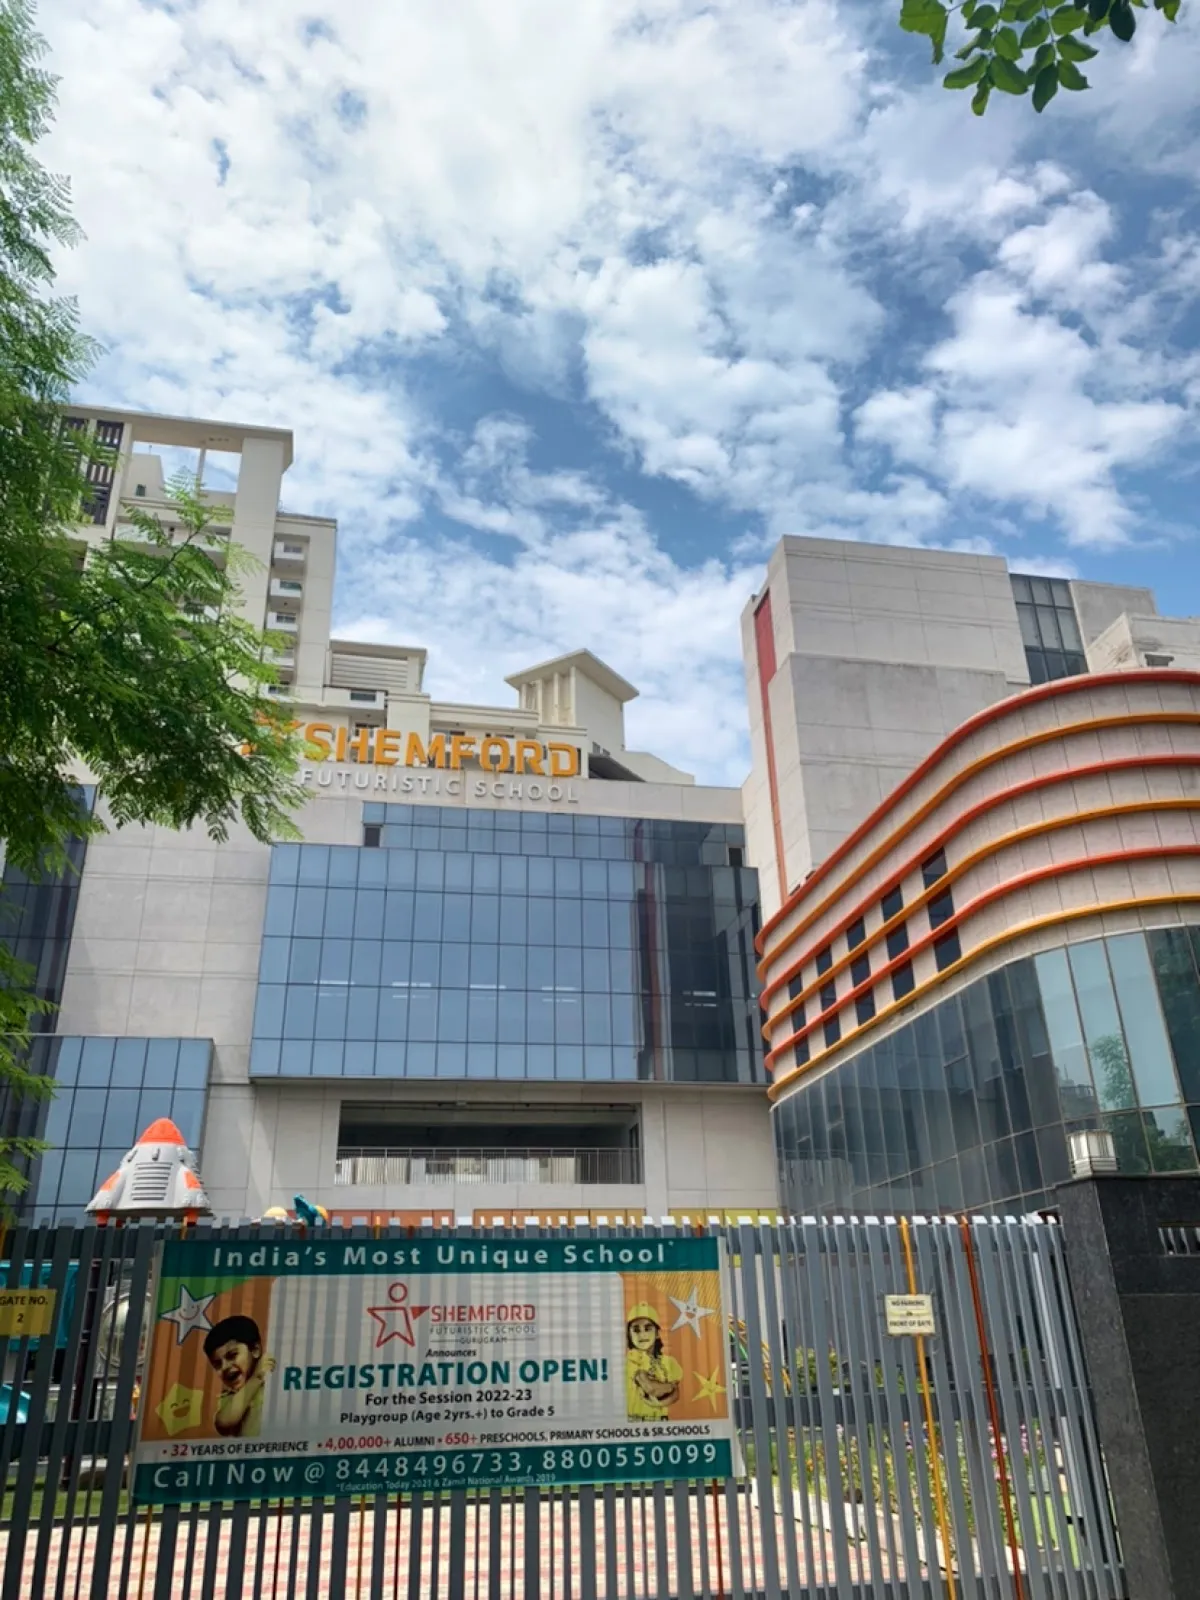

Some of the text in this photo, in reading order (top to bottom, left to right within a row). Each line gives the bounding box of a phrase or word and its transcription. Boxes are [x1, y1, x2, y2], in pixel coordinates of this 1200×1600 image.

[303, 721, 580, 777] SHEMFORD
[300, 768, 579, 803] FUTURISTIC SCHOOL
[343, 1246, 421, 1265] Most
[437, 1245, 549, 1268] Unique
[0, 1295, 48, 1305] GATE NO.
[17, 1313, 24, 1323] 2
[431, 1304, 536, 1322] SHEMFORD
[430, 1325, 536, 1335] FUTURISTIC SCHOOL
[460, 1337, 508, 1345] GURUGRAM
[425, 1349, 477, 1358] Announces
[283, 1357, 608, 1391] REGISTRATION OPEN!
[365, 1389, 533, 1406] For the Session 2022-23
[340, 1405, 555, 1426] Playgroup (Age 2yrs.+) to Grade 5
[325, 1435, 435, 1451] 4,00,000+ ALUMNI
[445, 1432, 478, 1445] 650+
[480, 1430, 549, 1443] PRESCHOOLS,
[550, 1429, 594, 1440] PRIMARY
[596, 1427, 641, 1439] SCHOOLS
[642, 1427, 651, 1437] &
[170, 1441, 309, 1457] 32 YEARS OF EXPERIENCE
[154, 1443, 717, 1488] Call Now @ 8448496733, 8800550099
[386, 1479, 410, 1490] Today
[412, 1478, 431, 1489] 2021
[467, 1475, 501, 1486] National
[503, 1474, 535, 1485] Awards
